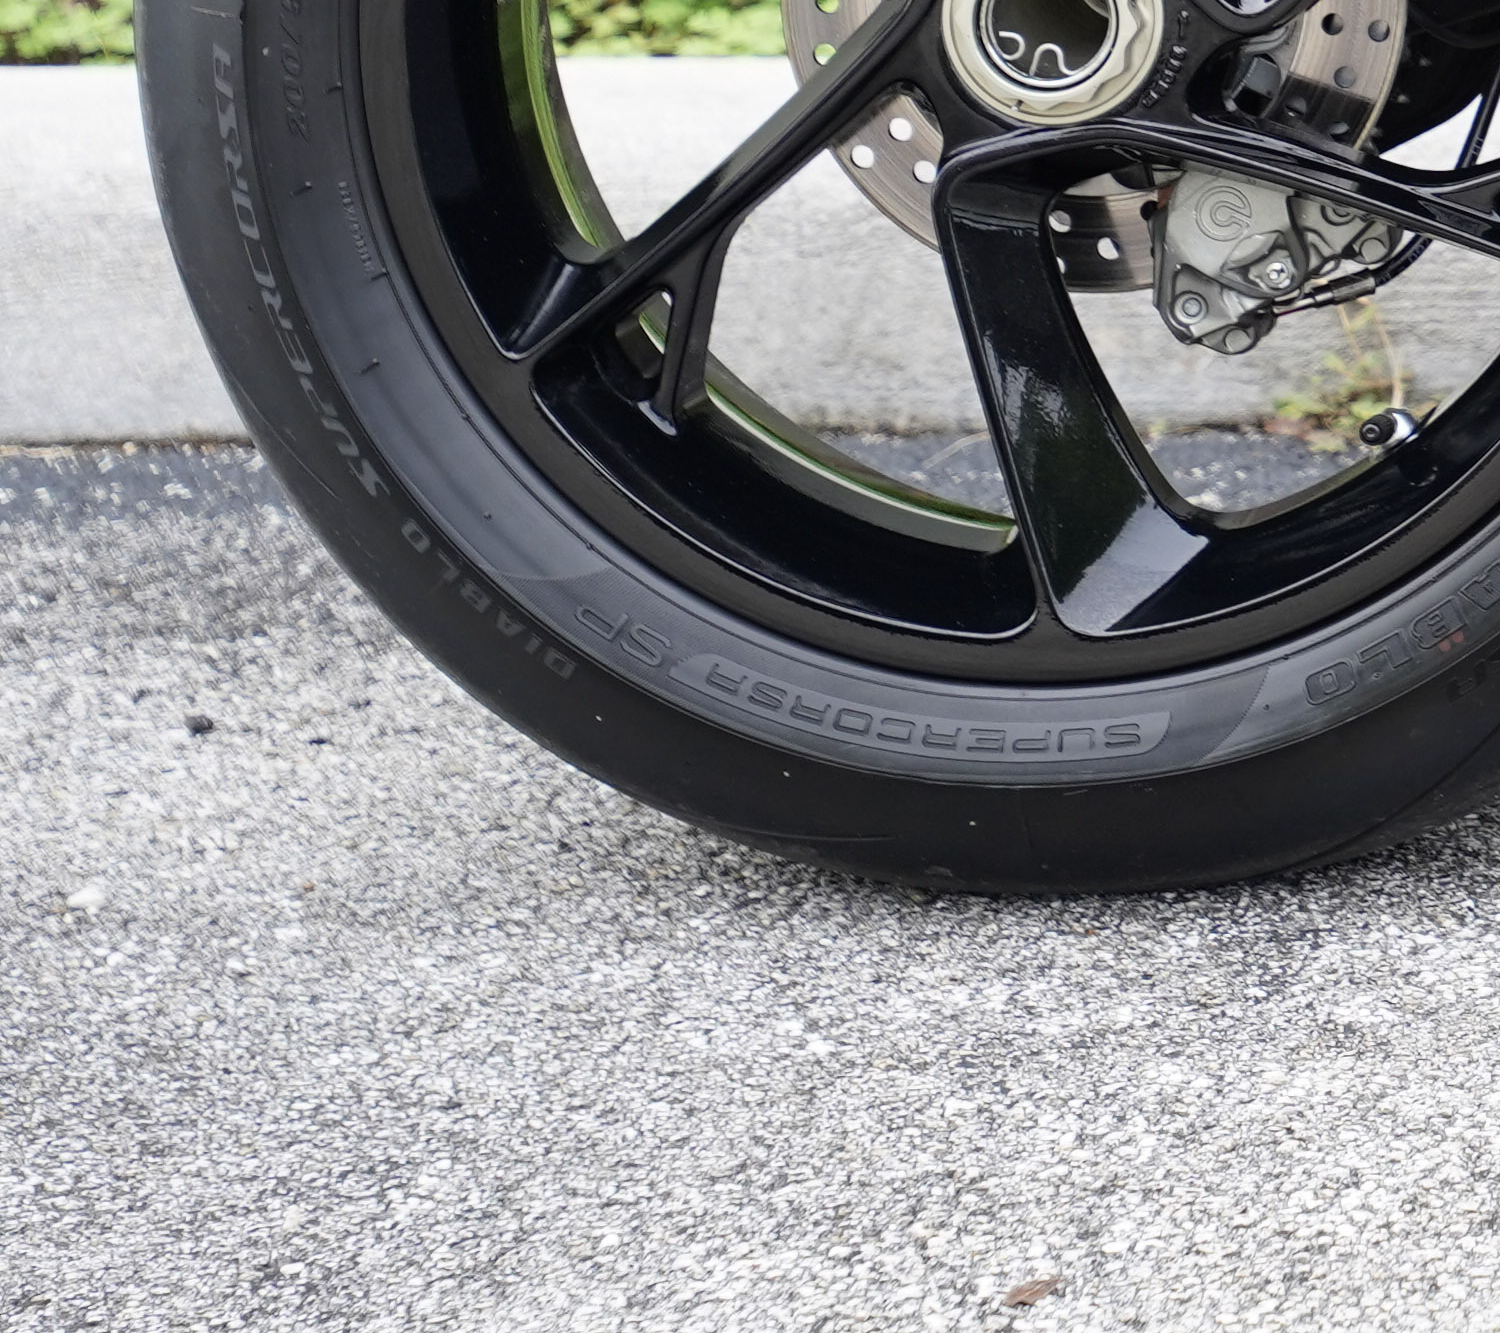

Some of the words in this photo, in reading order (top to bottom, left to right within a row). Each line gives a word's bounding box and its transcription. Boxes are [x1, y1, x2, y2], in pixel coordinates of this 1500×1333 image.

[211, 40, 392, 503] SUPERCORSA
[395, 514, 580, 682] DIABLO
[569, 587, 673, 671] SP
[704, 661, 1141, 753] SUPERCORSA
